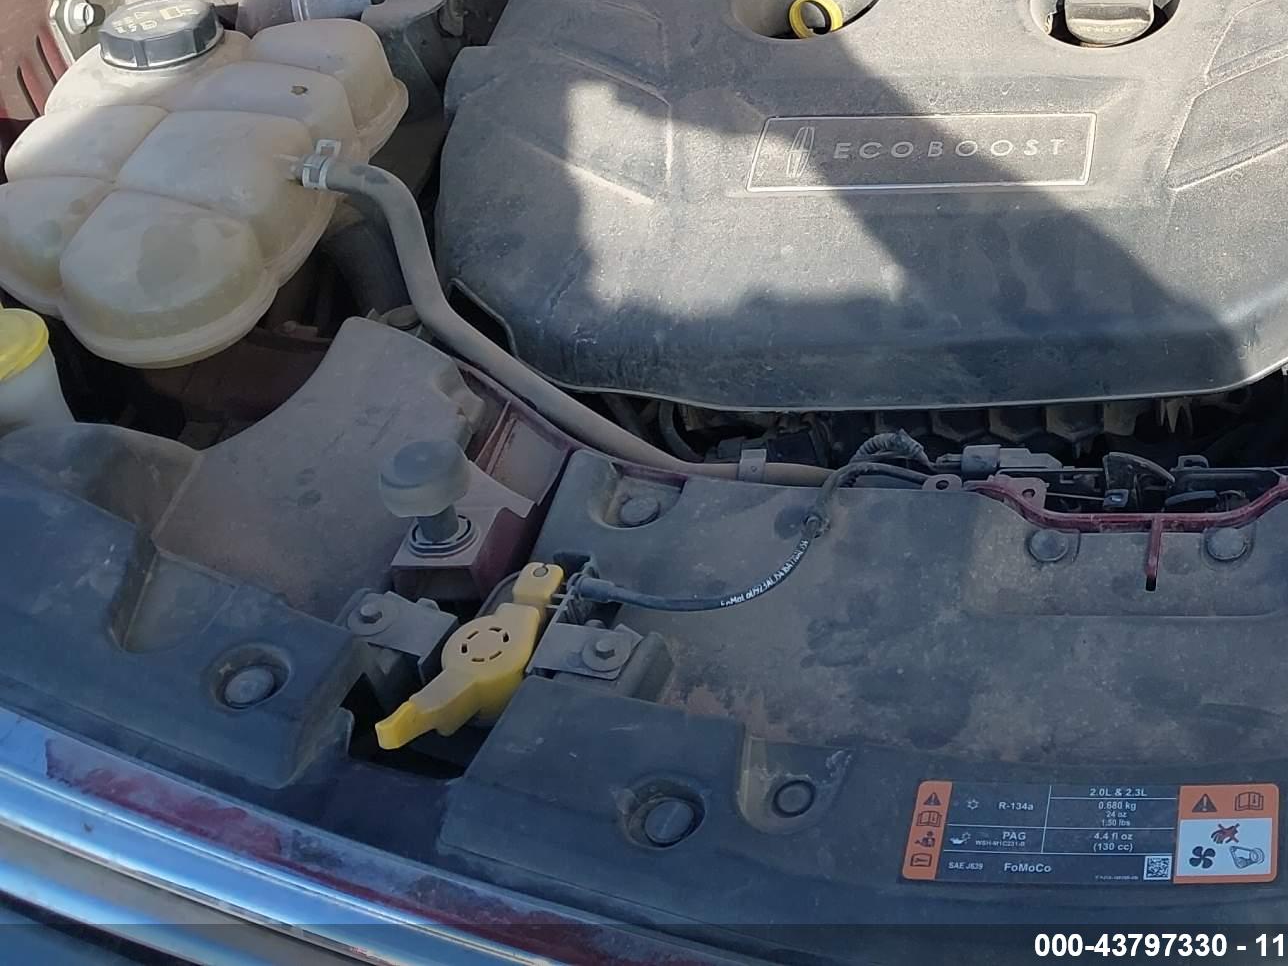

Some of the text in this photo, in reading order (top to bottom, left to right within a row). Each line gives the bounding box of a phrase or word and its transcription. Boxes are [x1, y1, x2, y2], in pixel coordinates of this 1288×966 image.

[833, 139, 1065, 159] ECOBOOST
[1089, 788, 1148, 797] 2.0L & 2.3L
[998, 801, 1034, 811] R-134a
[1098, 801, 1137, 812] 0.680 kg
[1105, 810, 1116, 818] 24
[1101, 818, 1131, 827] 1.50 lbs
[1002, 831, 1027, 840] PAG
[1093, 832, 1109, 840] 4.4
[1111, 832, 1118, 840] fl
[1093, 842, 1134, 852] (130 cc)
[948, 861, 965, 869] SAE
[1003, 862, 1052, 873] FoMoCo
